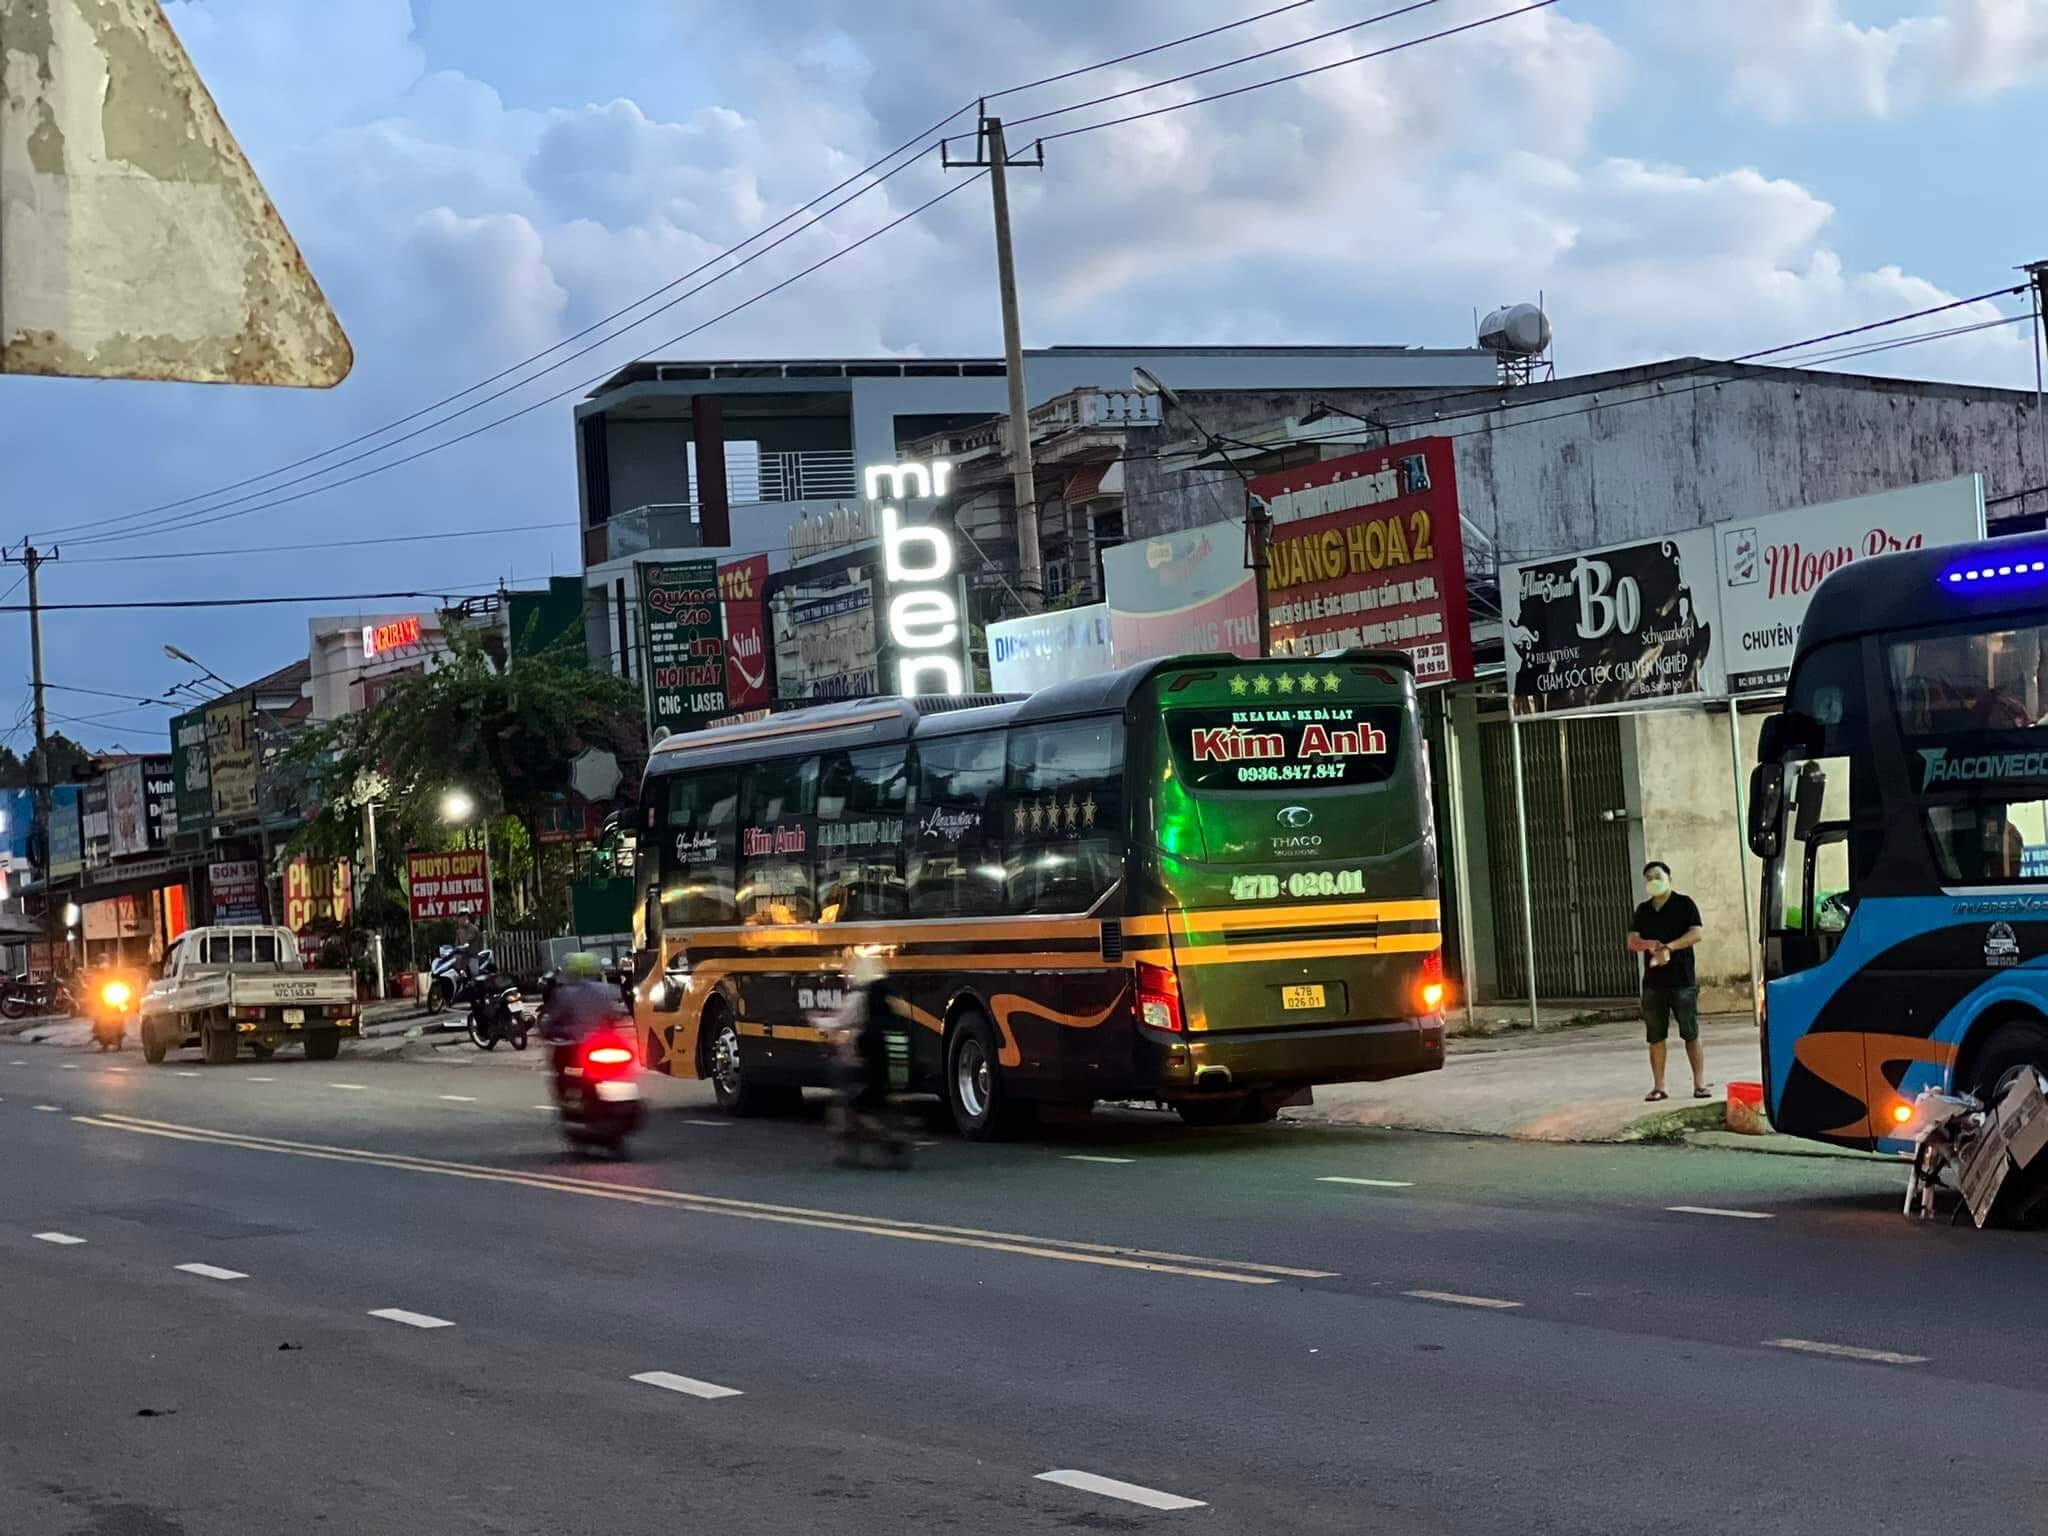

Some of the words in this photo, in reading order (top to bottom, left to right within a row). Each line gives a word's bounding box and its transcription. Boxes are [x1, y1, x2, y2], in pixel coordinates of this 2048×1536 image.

[865, 461, 951, 500] mr
[1345, 515, 1411, 574] HOA
[882, 507, 962, 698] ben
[1570, 557, 1641, 639] Bo
[374, 616, 420, 653] AGRIBANK
[732, 627, 761, 658] Sinh
[1743, 622, 1793, 651] CHUYÊN
[656, 662, 683, 694] NỘI
[686, 656, 722, 687] THẤT
[1565, 662, 1588, 689] SÓC
[1590, 660, 1613, 684] TÓC
[1655, 652, 1688, 678] NGHIỆP
[659, 695, 681, 715] CNC
[691, 692, 724, 713] LASER
[1232, 711, 1248, 723] BX
[1250, 711, 1265, 722] EA
[1267, 710, 1290, 722] KAR
[1297, 710, 1312, 721] BX
[1191, 724, 1285, 762] Kim
[1297, 722, 1387, 758] Anh
[1237, 763, 1346, 783] 0936.847.847
[775, 823, 806, 854] Anh
[1270, 835, 1323, 849] THACO
[288, 863, 344, 898] PHOTO
[452, 854, 483, 876] COPY
[288, 897, 345, 933] COPY
[1286, 996, 1322, 1009] 026.01
[1293, 986, 1314, 998] 47B
